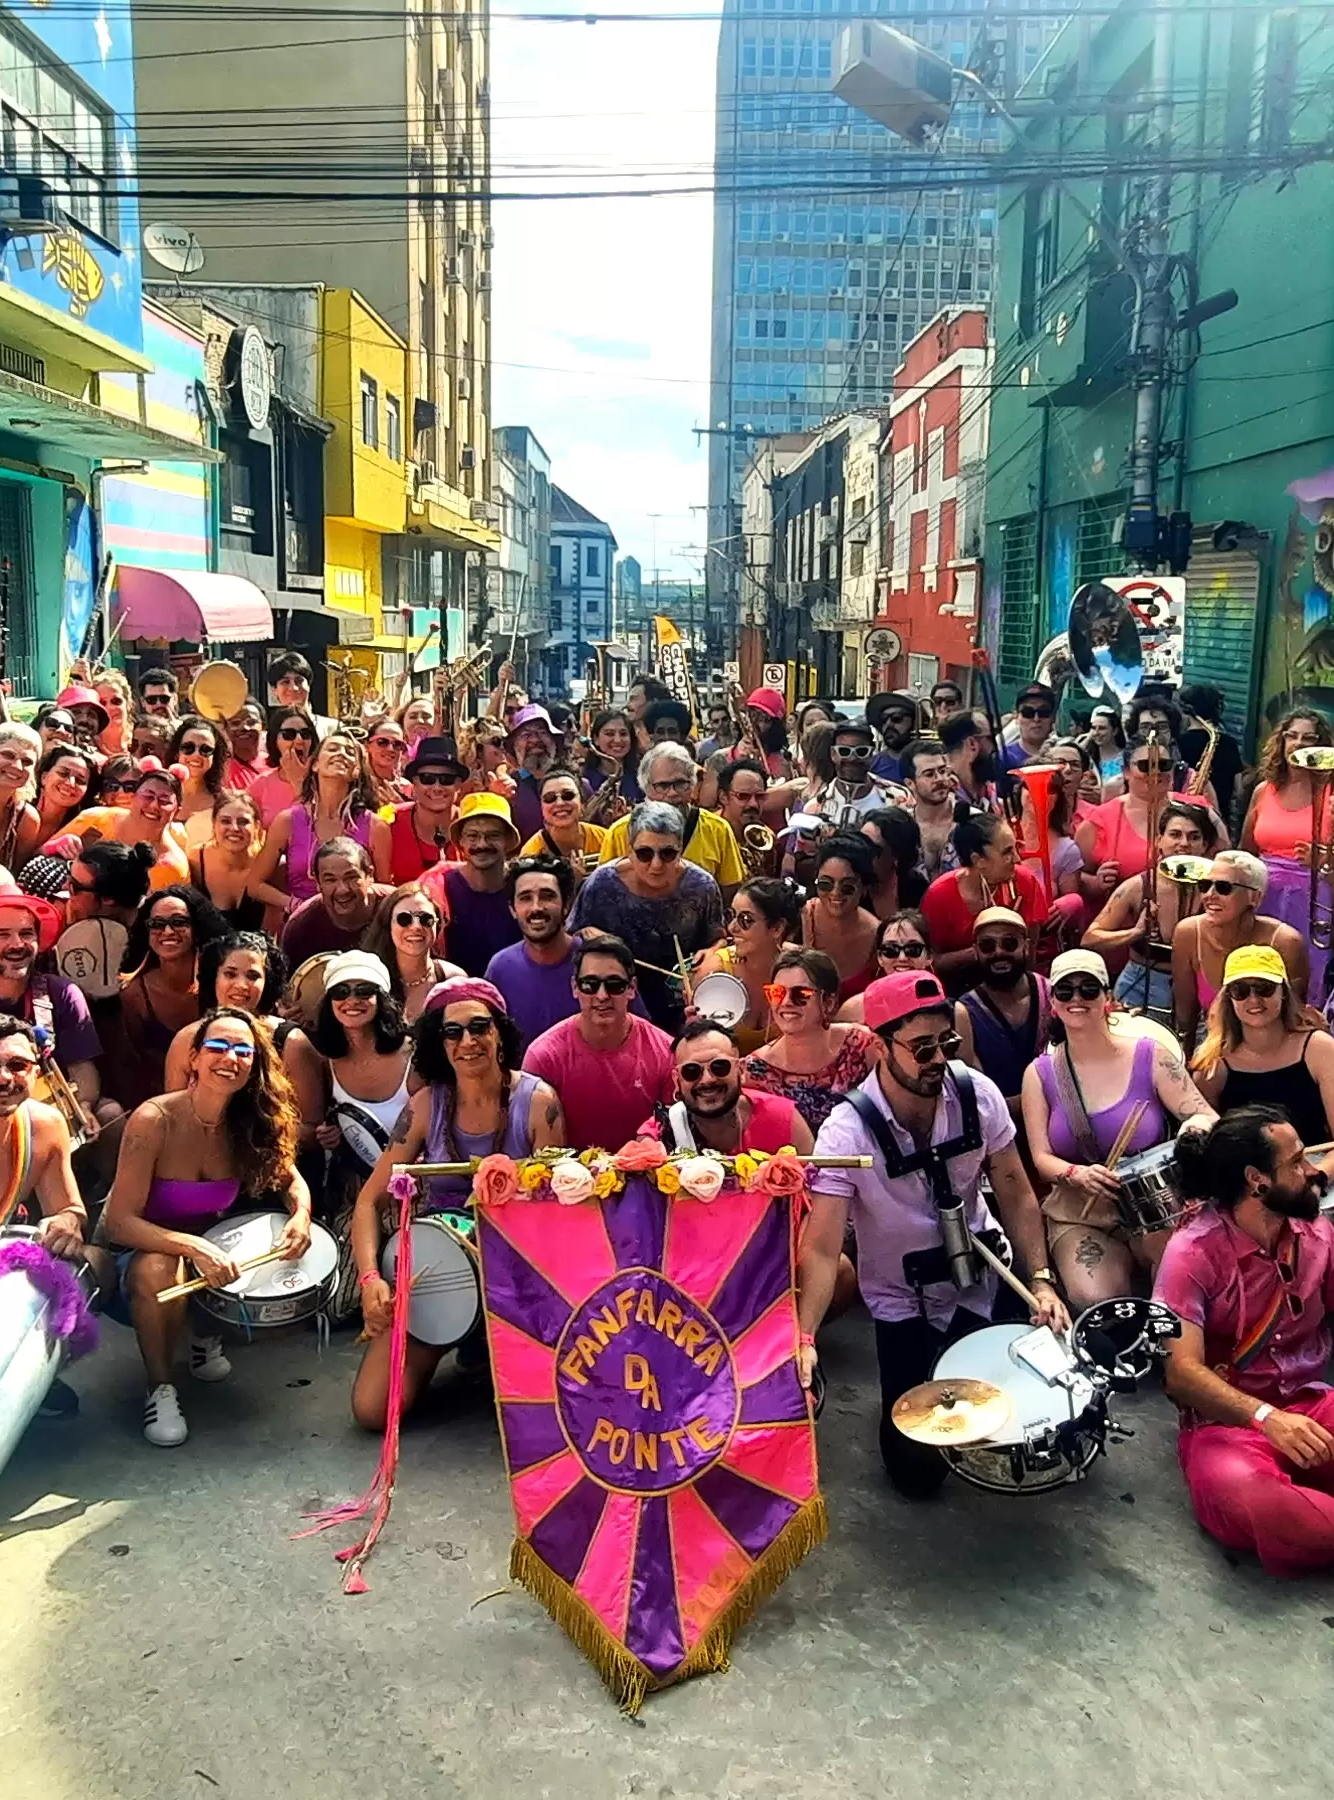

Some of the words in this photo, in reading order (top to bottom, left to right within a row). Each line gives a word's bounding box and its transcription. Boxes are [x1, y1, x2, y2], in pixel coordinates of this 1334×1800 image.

[152, 233, 187, 247] vivo
[1149, 658, 1161, 667] DA
[1163, 657, 1176, 667] VIA
[560, 1287, 725, 1386] FANFARRA
[623, 1354, 663, 1412] DA
[586, 1415, 726, 1472] PONTE
